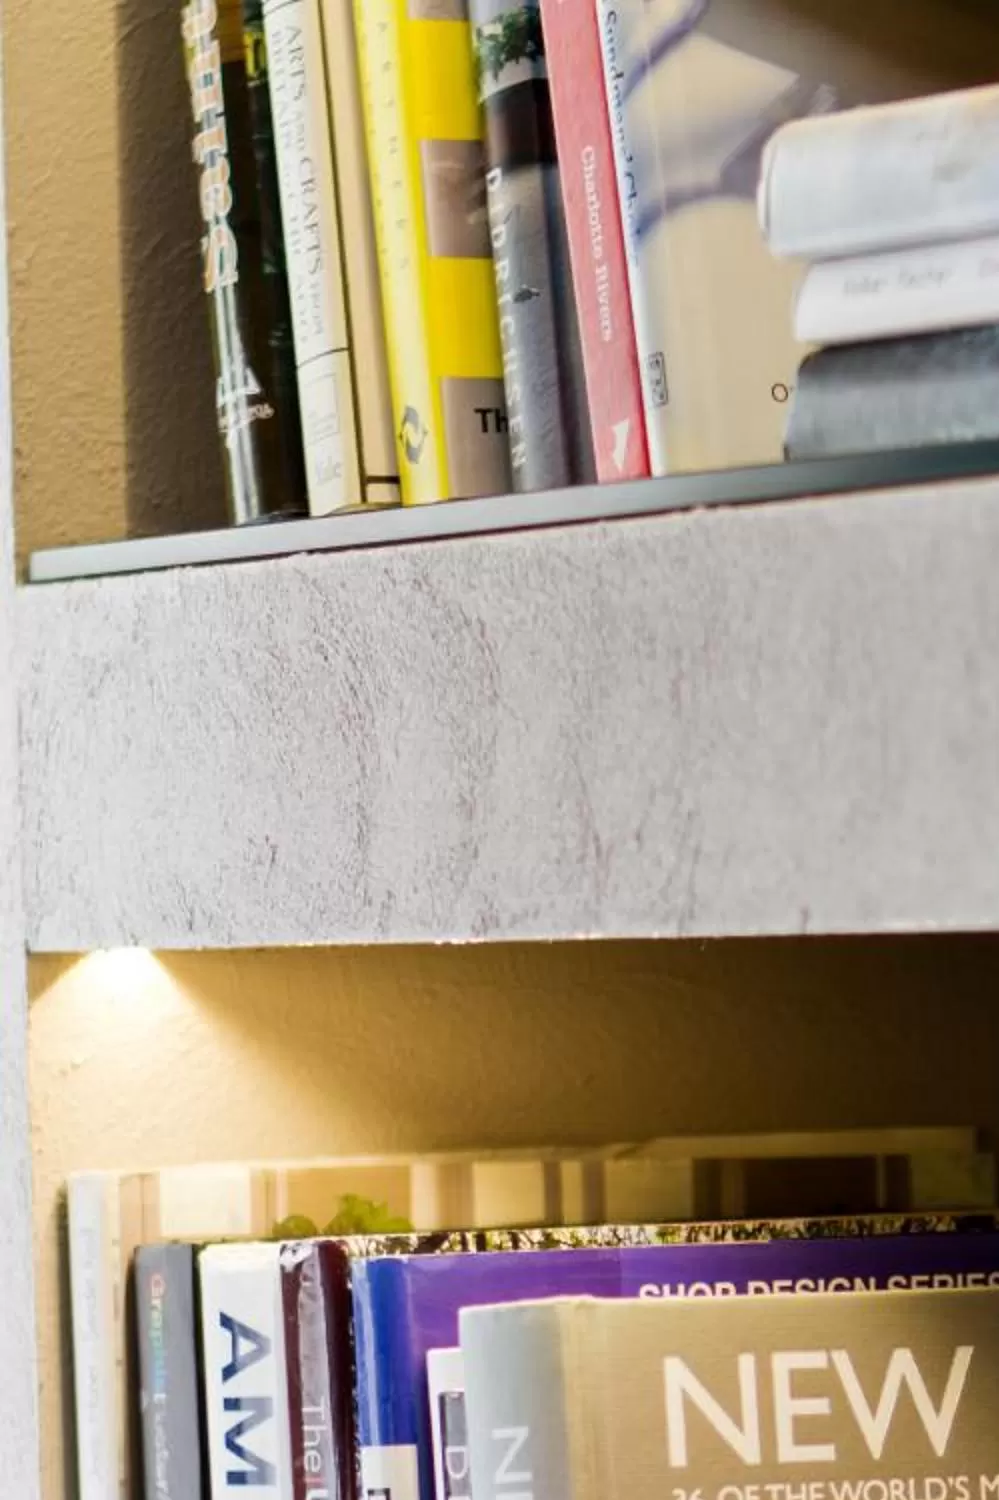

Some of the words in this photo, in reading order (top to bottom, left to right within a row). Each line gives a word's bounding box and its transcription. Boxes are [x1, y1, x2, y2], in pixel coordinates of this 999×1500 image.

[286, 24, 309, 100] ARTS
[296, 156, 326, 276] CRAFTS
[577, 144, 609, 260] Charlotte
[593, 265, 616, 342] Rivers
[301, 1396, 322, 1475] The
[662, 1345, 973, 1469] NEW
